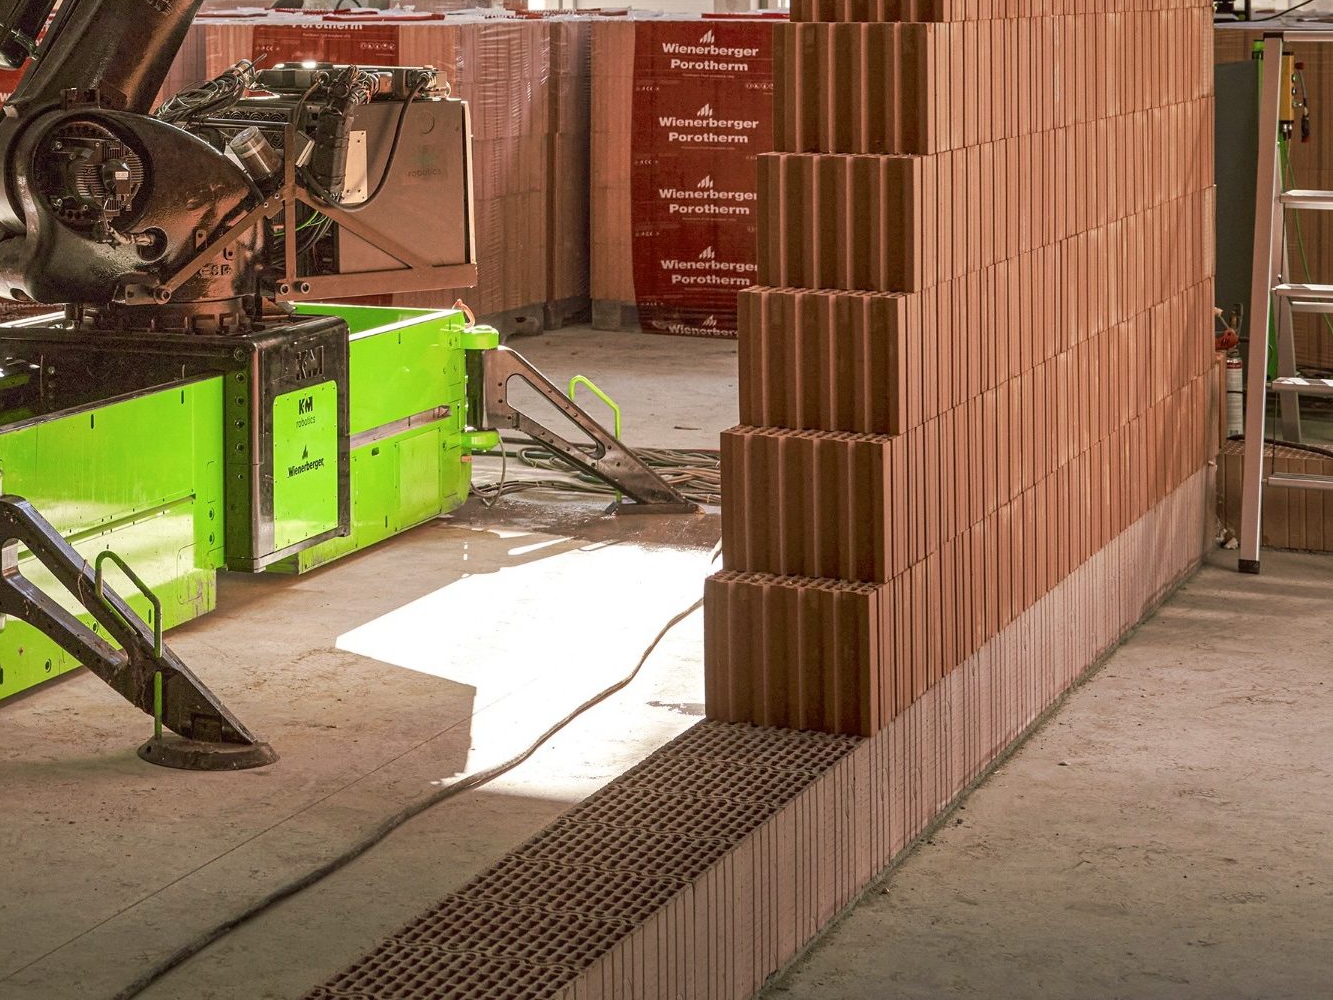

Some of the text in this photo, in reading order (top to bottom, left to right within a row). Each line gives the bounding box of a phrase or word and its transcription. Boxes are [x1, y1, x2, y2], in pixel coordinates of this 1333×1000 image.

[661, 42, 759, 57] Wienerberger
[670, 58, 749, 72] Porotherm
[659, 116, 759, 130] Wienerberger
[668, 132, 749, 144] Porotherm
[669, 203, 750, 215] Porotherm
[671, 274, 751, 286] Porotherm
[668, 323, 739, 338] Wienerber
[295, 414, 316, 429] robotics
[287, 457, 325, 478] Wienerberger
